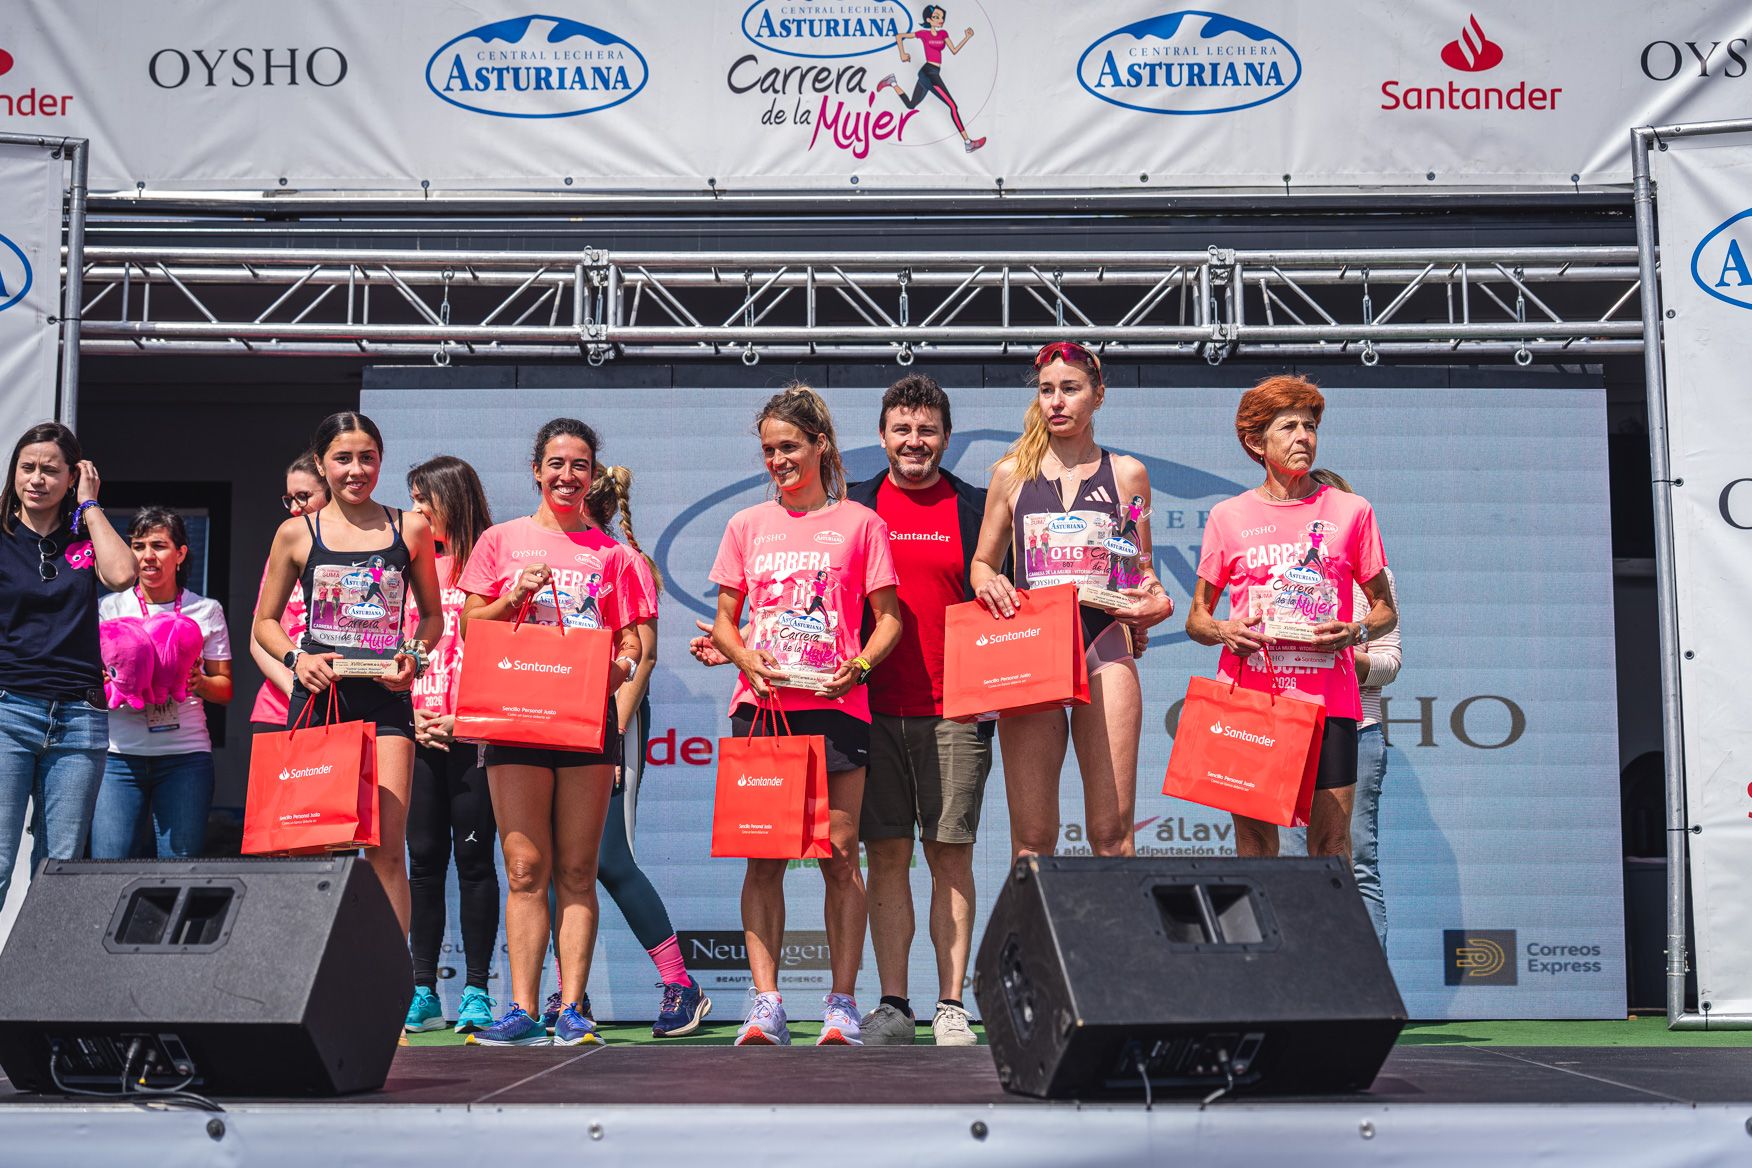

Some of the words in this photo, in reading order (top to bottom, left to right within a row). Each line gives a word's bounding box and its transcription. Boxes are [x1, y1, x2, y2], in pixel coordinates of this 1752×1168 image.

[781, 6, 835, 14] CENTRAL
[840, 5, 894, 14] LECHERA
[755, 8, 899, 38] ASTURIANA
[476, 50, 547, 61] CENTRAL
[554, 49, 624, 60] LECHERA
[1129, 47, 1199, 58] CENTRAL
[1208, 46, 1278, 57] LECHERA
[1640, 38, 1748, 81] OYS
[148, 46, 348, 89] OYSHO
[442, 53, 632, 93] ASTURIANA
[727, 53, 867, 96] Carrera
[1098, 49, 1285, 89] ASTURIANA
[1381, 80, 1563, 112] Santander
[761, 97, 787, 127] de
[793, 95, 811, 127] la
[808, 92, 921, 159] Mujer
[1051, 522, 1085, 531] ASTURIANA
[1241, 524, 1277, 538] OYSHO
[754, 533, 787, 545] OYSHO
[889, 530, 951, 543] Santander
[511, 549, 547, 559] OYSHO
[1050, 547, 1084, 559] 016
[1106, 541, 1135, 554] ASTURIANA
[755, 551, 831, 574] CARRERA
[1090, 547, 1130, 566] Carrera
[1034, 578, 1061, 587] OYSHO
[1288, 571, 1319, 582] ASTURIANA
[1273, 579, 1315, 595] Carrera
[351, 608, 382, 616] ASTURIANA
[1292, 594, 1338, 620] Mujer
[338, 616, 380, 629] Carrera
[792, 619, 823, 631] ASTURIANA
[360, 627, 403, 655] Mujer
[780, 627, 820, 643] Carrera
[989, 627, 1041, 645] Santander
[513, 659, 573, 675] Santander
[425, 695, 443, 707] 2026
[1223, 725, 1276, 747] Santander
[646, 728, 713, 766] de
[290, 764, 333, 779] Santander
[1207, 770, 1224, 780] Sencillo
[1223, 775, 1243, 785] Personal
[1243, 780, 1256, 788] Justo
[747, 775, 784, 787] Santander
[1156, 817, 1232, 842] álav
[1137, 845, 1214, 857] diputación
[1527, 942, 1601, 958] Correos
[1528, 959, 1602, 976] Express
